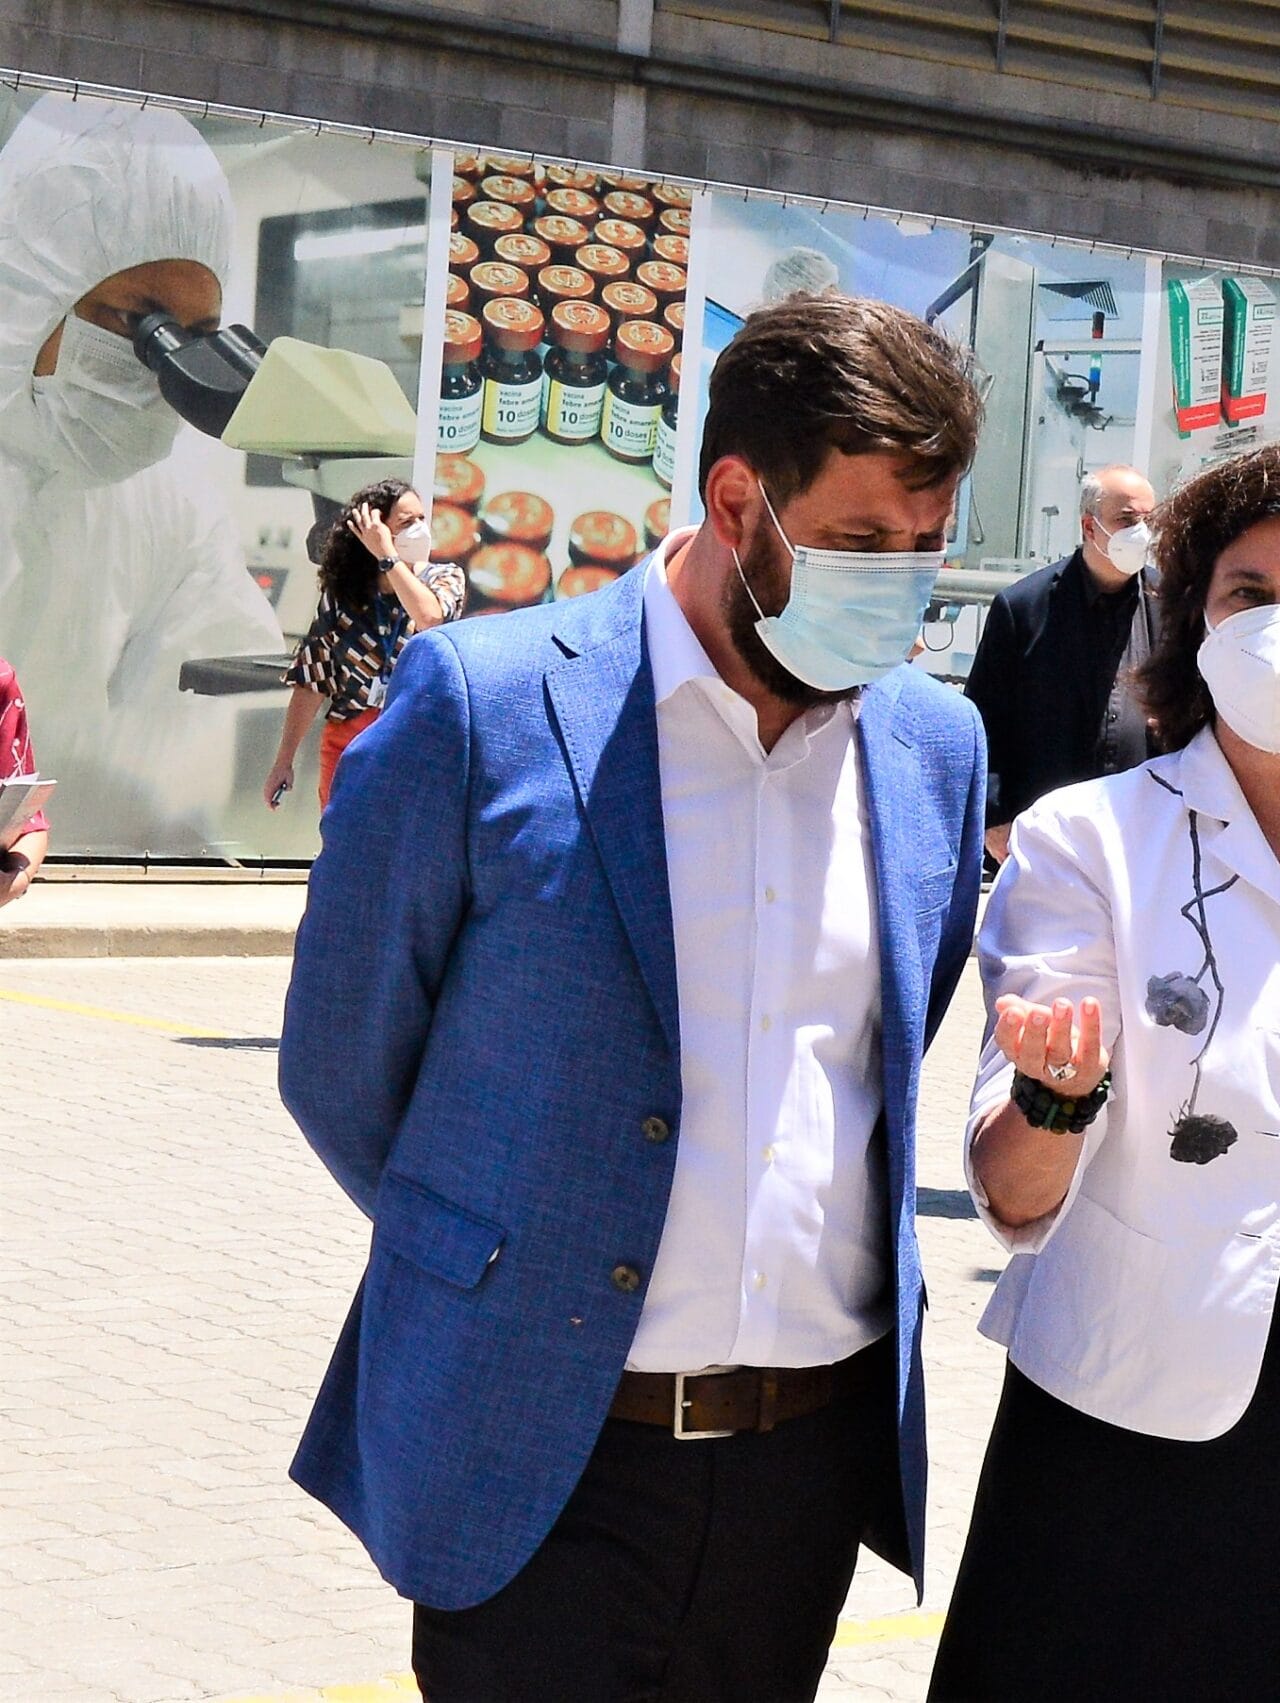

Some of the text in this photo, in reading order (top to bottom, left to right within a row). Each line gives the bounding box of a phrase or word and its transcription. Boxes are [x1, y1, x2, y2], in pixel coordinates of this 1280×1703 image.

[497, 410, 516, 423] 10
[560, 411, 578, 424] 10
[438, 426, 457, 438] 10
[609, 421, 624, 438] 10
[624, 429, 648, 439] doses
